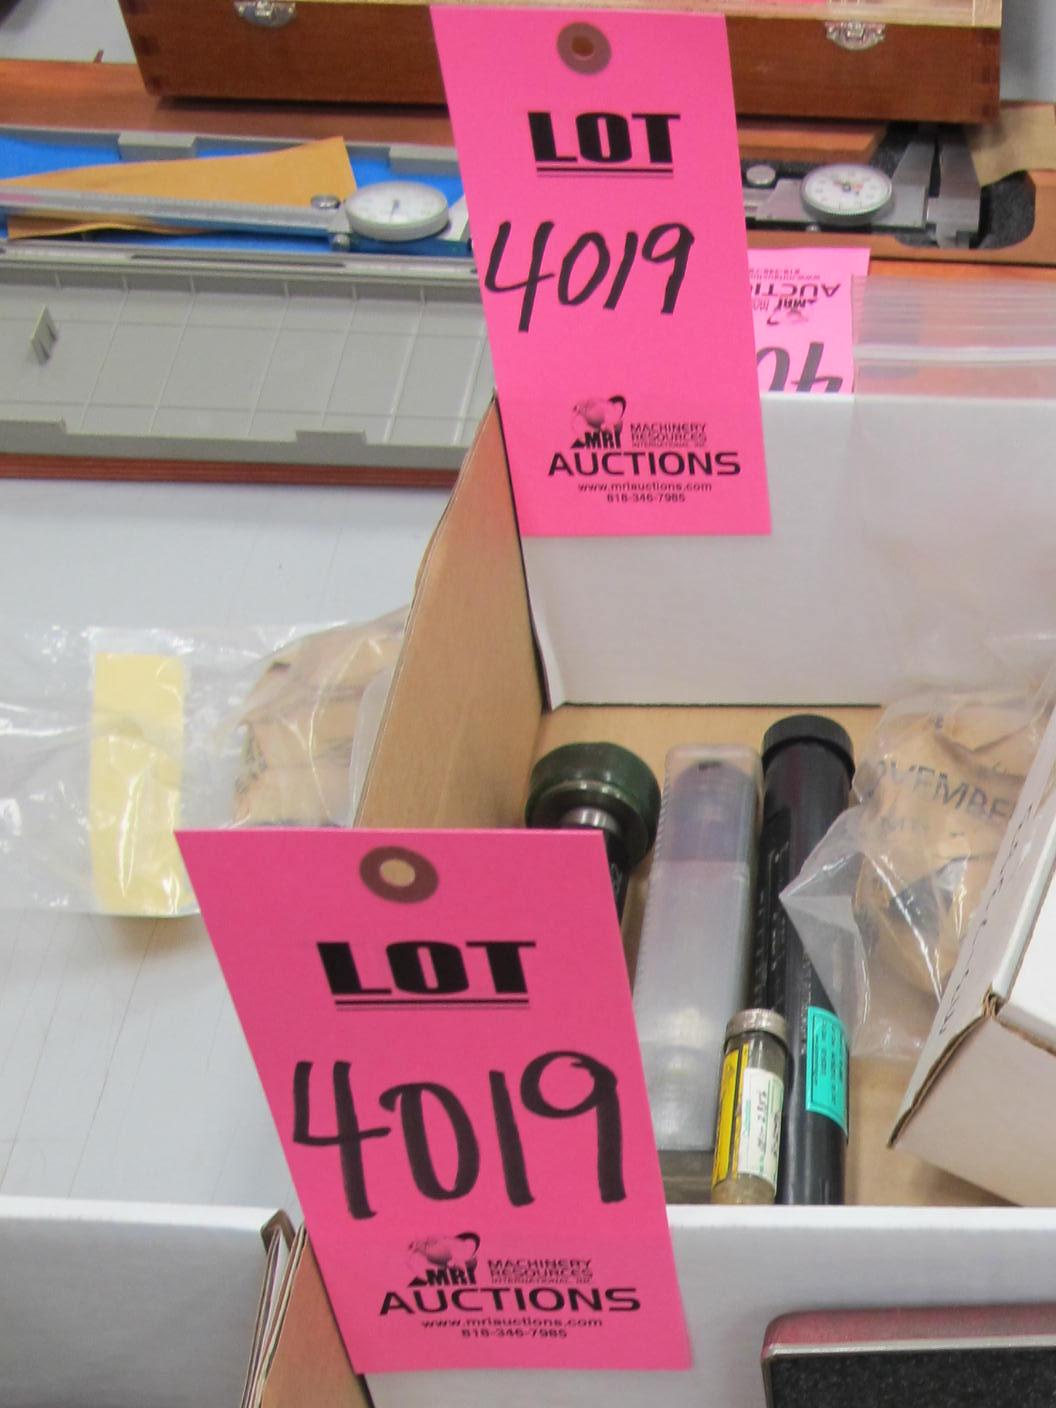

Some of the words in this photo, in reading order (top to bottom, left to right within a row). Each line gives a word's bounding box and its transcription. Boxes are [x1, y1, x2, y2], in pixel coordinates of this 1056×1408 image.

[527, 111, 681, 164] LOT
[484, 219, 695, 333] 4019
[750, 282, 841, 298] AUCTI
[630, 423, 706, 434] MACHINERY
[548, 452, 741, 476] AUCTIONS
[578, 482, 712, 492] www.mriauctions.com
[316, 940, 536, 995] LOT
[293, 1051, 627, 1220] 4019
[488, 1259, 593, 1269] MACHINERY
[380, 1287, 641, 1316] AUCTIONS
[421, 1317, 603, 1328] www.mriauctions.com
